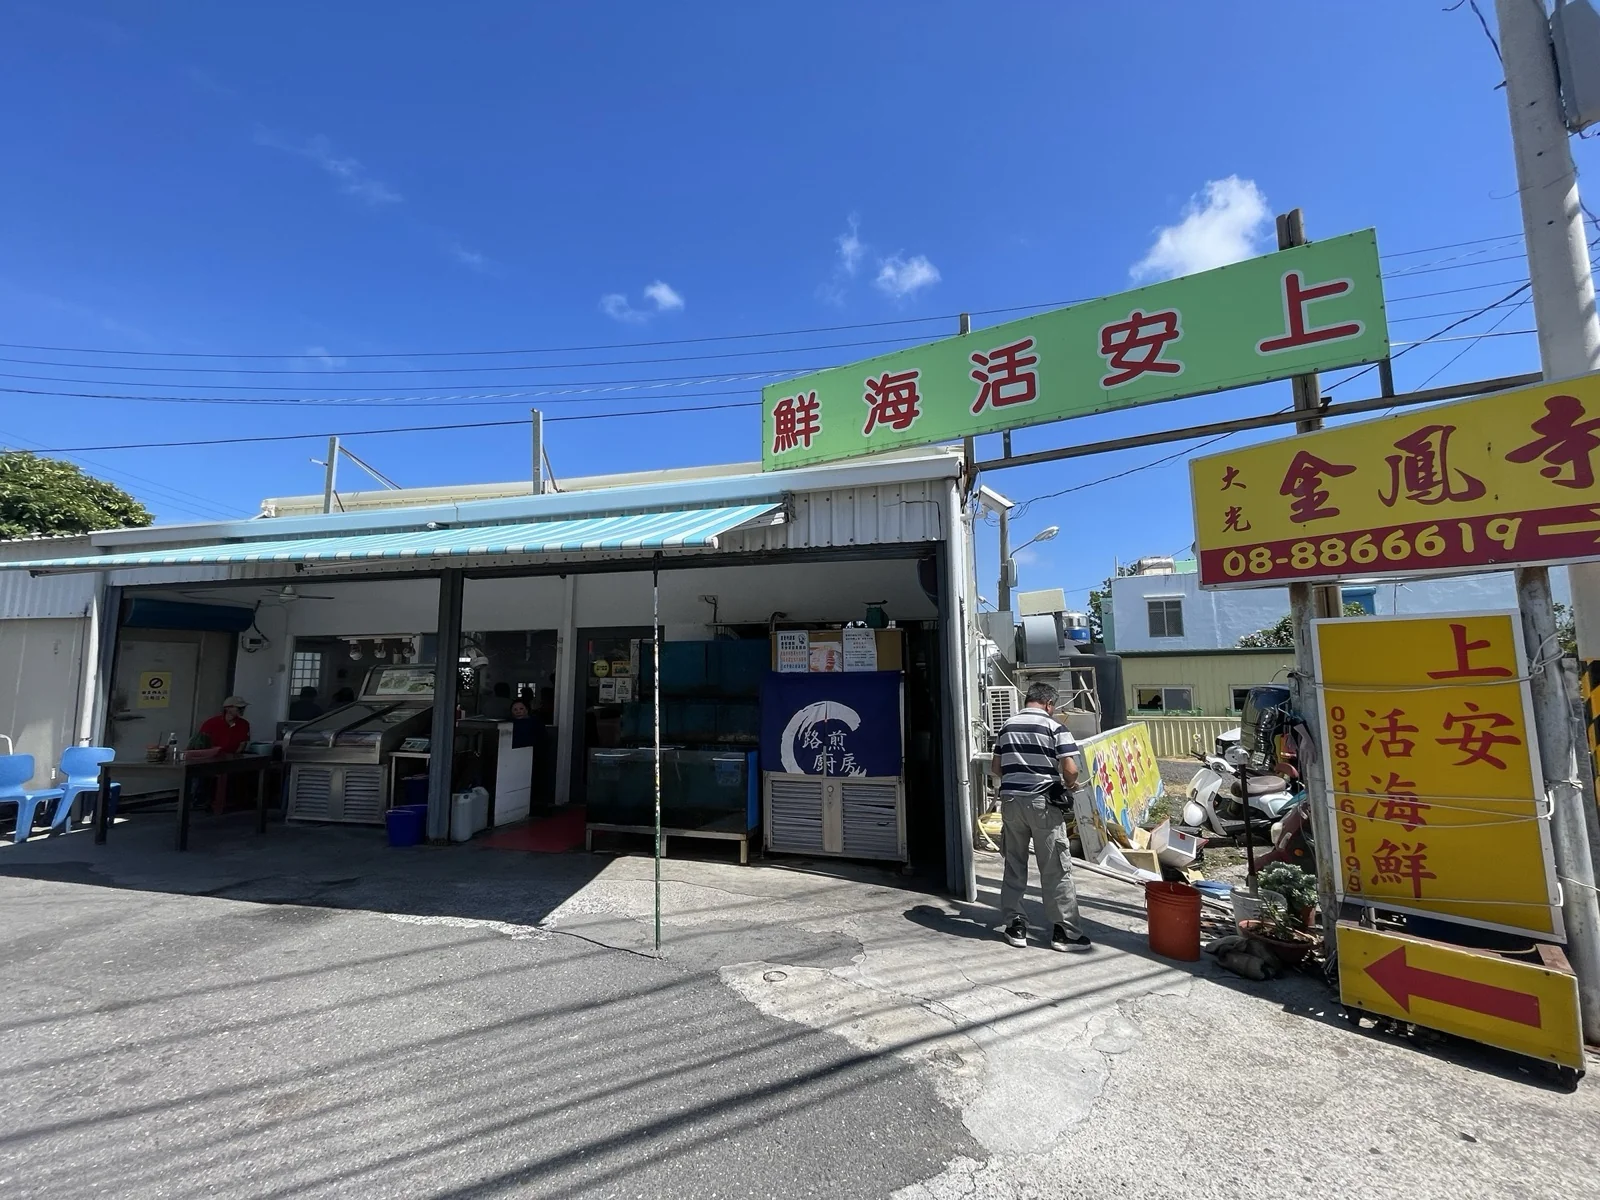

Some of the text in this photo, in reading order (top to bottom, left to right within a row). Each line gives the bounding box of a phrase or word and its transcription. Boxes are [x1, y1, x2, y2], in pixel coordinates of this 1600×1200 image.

[1223, 517, 1522, 577] 08-8866619
[1427, 624, 1521, 770] 上安
[1359, 709, 1437, 898] 活海鮮
